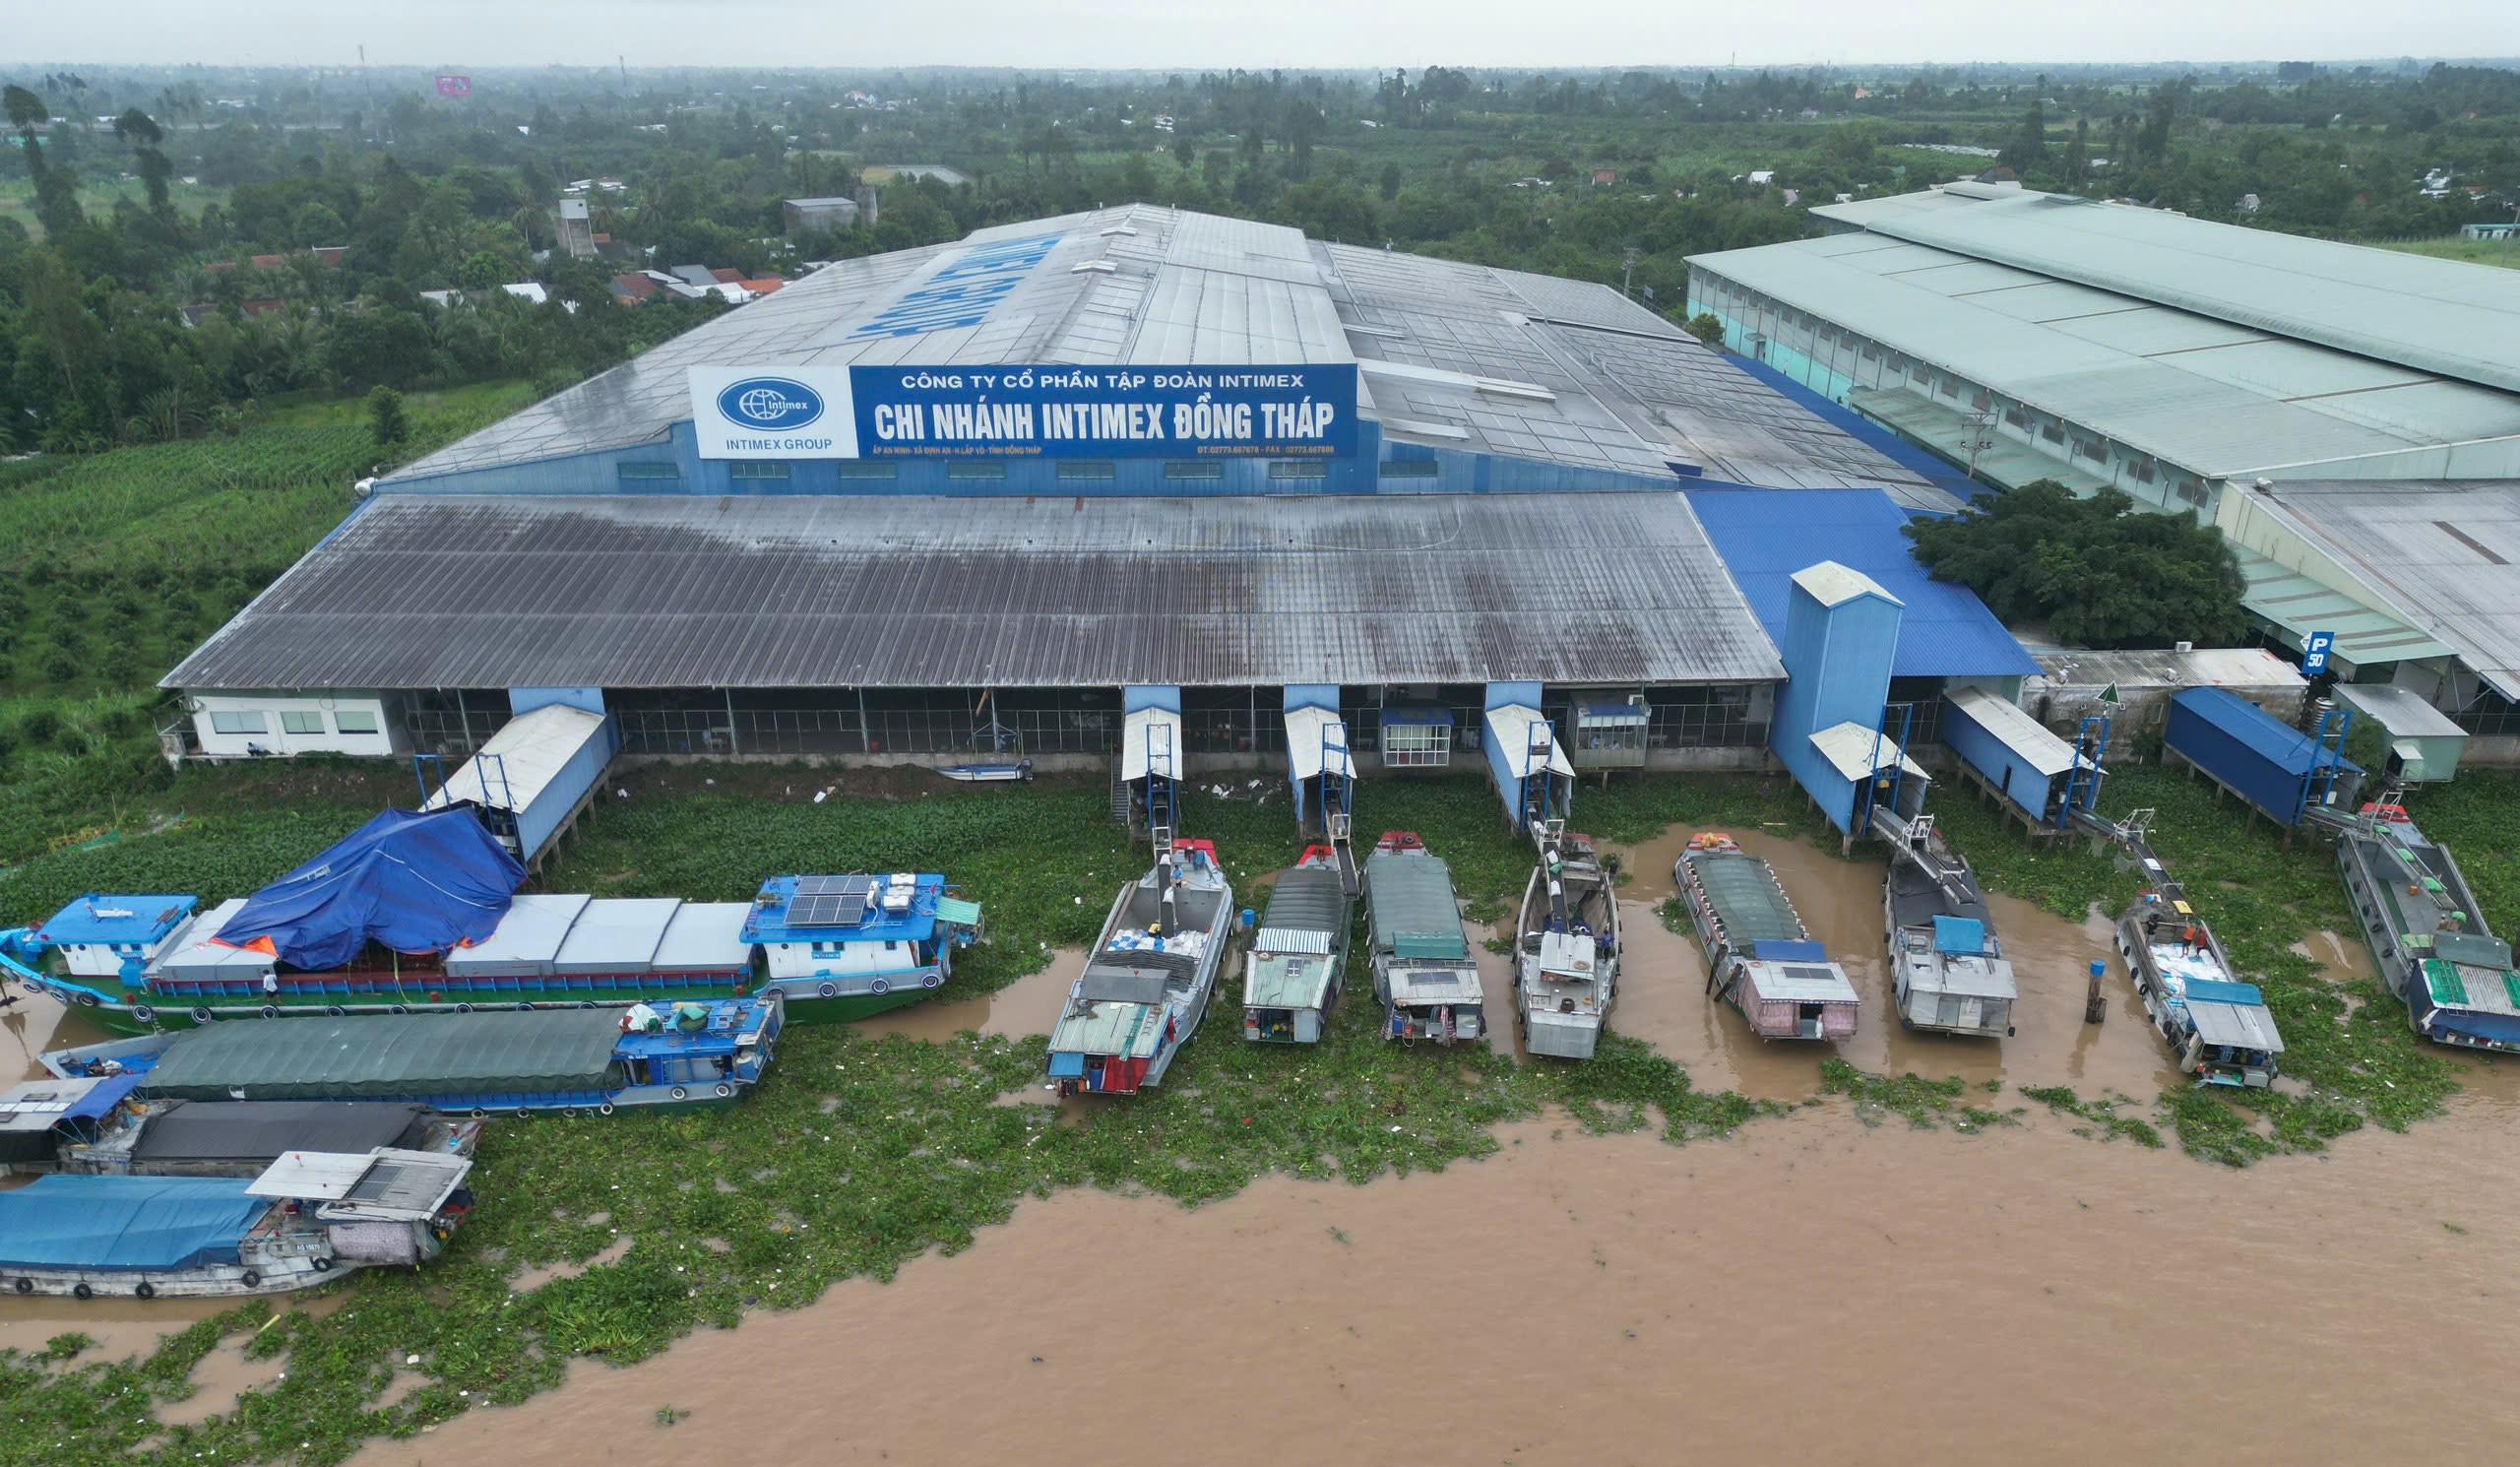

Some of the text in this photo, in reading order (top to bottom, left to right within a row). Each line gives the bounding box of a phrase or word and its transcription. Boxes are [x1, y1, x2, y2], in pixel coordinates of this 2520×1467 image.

[847, 277, 1025, 338] GROUP
[902, 368, 1304, 391] CÔNG TY CỔ PHẦN TẬP ĐOÀN INTIMEX
[768, 400, 808, 411] Intimex
[874, 392, 1335, 440] CHI NHÁNH INTIMEX ĐỒNG THÁP
[725, 438, 833, 450] INTIMEX GROUP
[2311, 638, 2328, 651] P
[2307, 654, 2324, 667] 50
